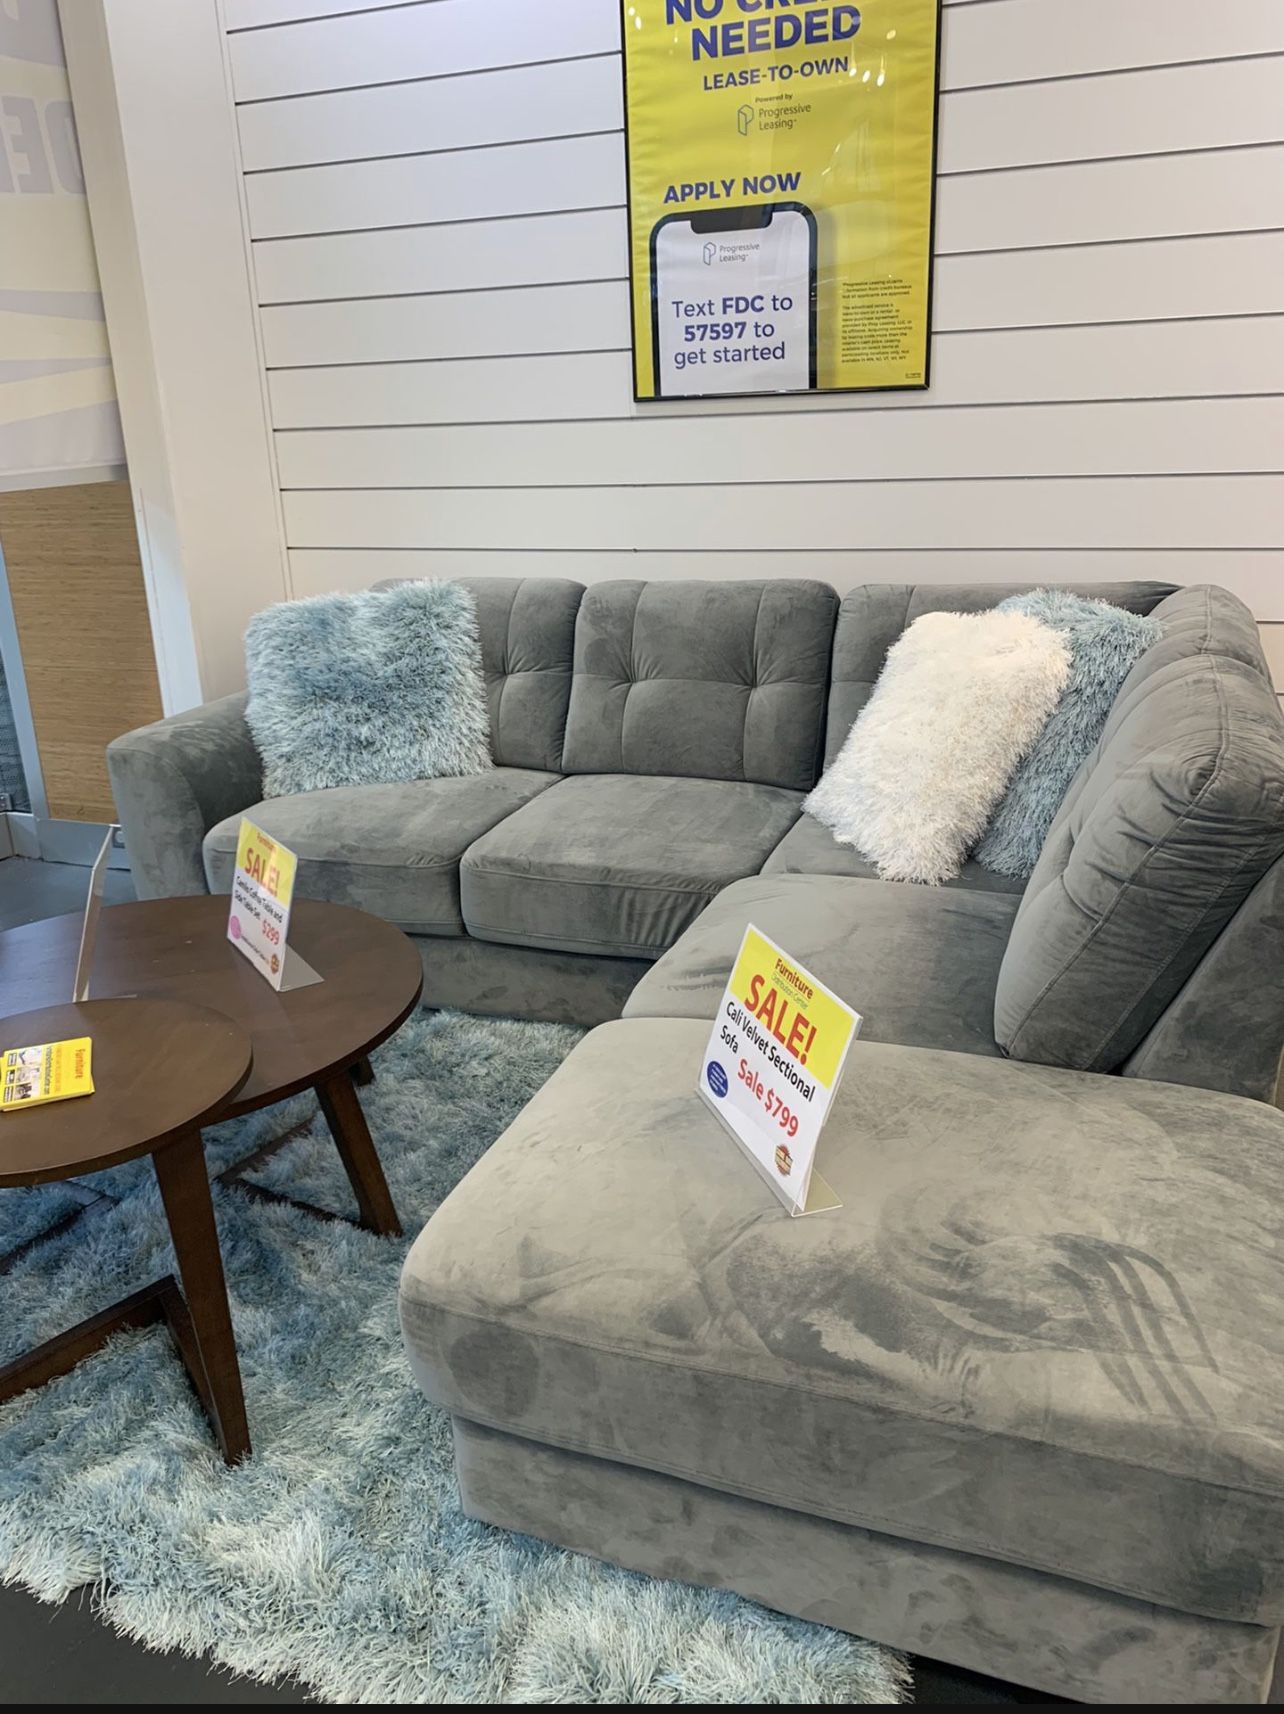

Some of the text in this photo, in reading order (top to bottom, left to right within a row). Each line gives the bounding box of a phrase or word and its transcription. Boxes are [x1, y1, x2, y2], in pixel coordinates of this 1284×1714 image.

[666, 0, 723, 25] NO
[692, 4, 861, 61] NEEDED
[703, 56, 849, 91] LEASE-TO-OWN
[759, 103, 812, 119] Progressive
[784, 92, 793, 101] by
[663, 172, 801, 204] APPLY NOW
[719, 242, 760, 255] Progressive
[672, 295, 793, 319] Text FDC to
[684, 321, 775, 342] 57597 to
[674, 341, 785, 369] get started
[775, 958, 813, 1000] Furniture
[744, 974, 817, 1066] SALE!
[720, 1025, 739, 1054] Sofa
[726, 1001, 816, 1102] Cali Velvet Sectional
[737, 1058, 763, 1101] Sale
[764, 1086, 799, 1137] $799
